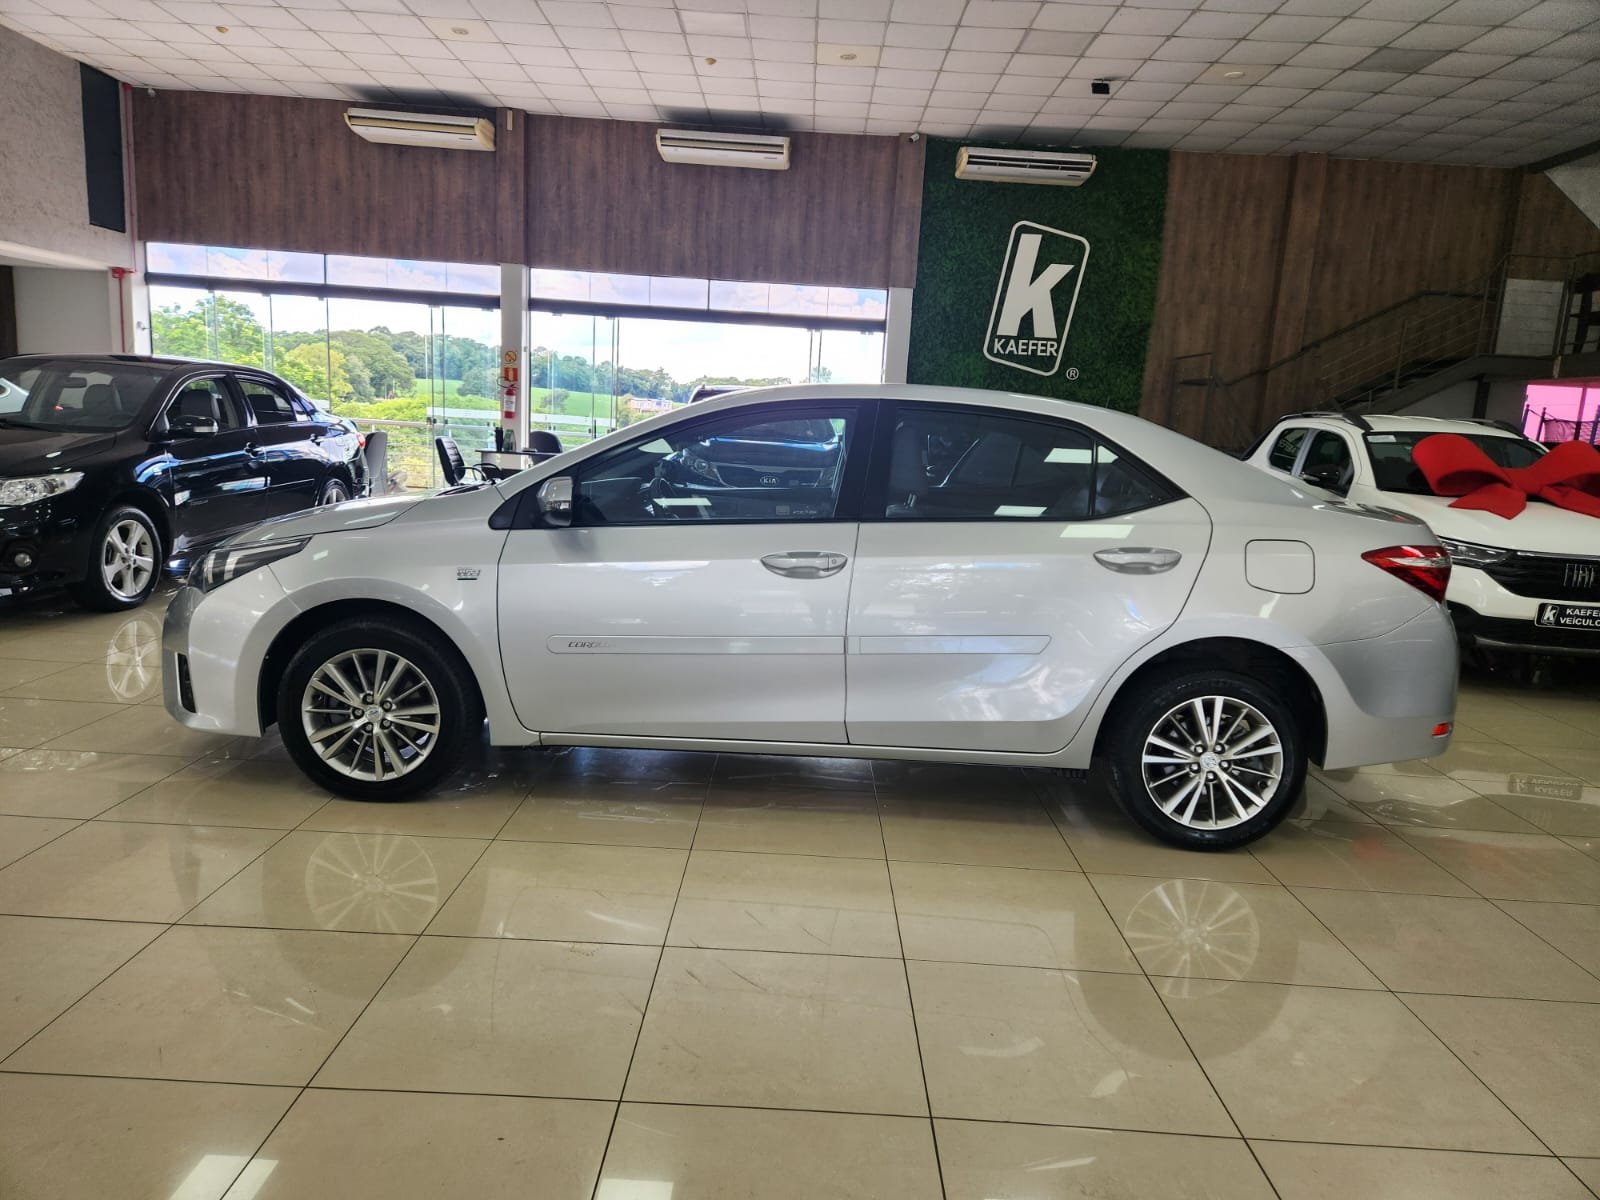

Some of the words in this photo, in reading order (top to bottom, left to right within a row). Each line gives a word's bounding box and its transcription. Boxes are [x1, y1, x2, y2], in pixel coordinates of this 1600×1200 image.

[993, 338, 1058, 357] KAEFER
[763, 477, 777, 485] KIA
[1566, 608, 1600, 617] KAEFE
